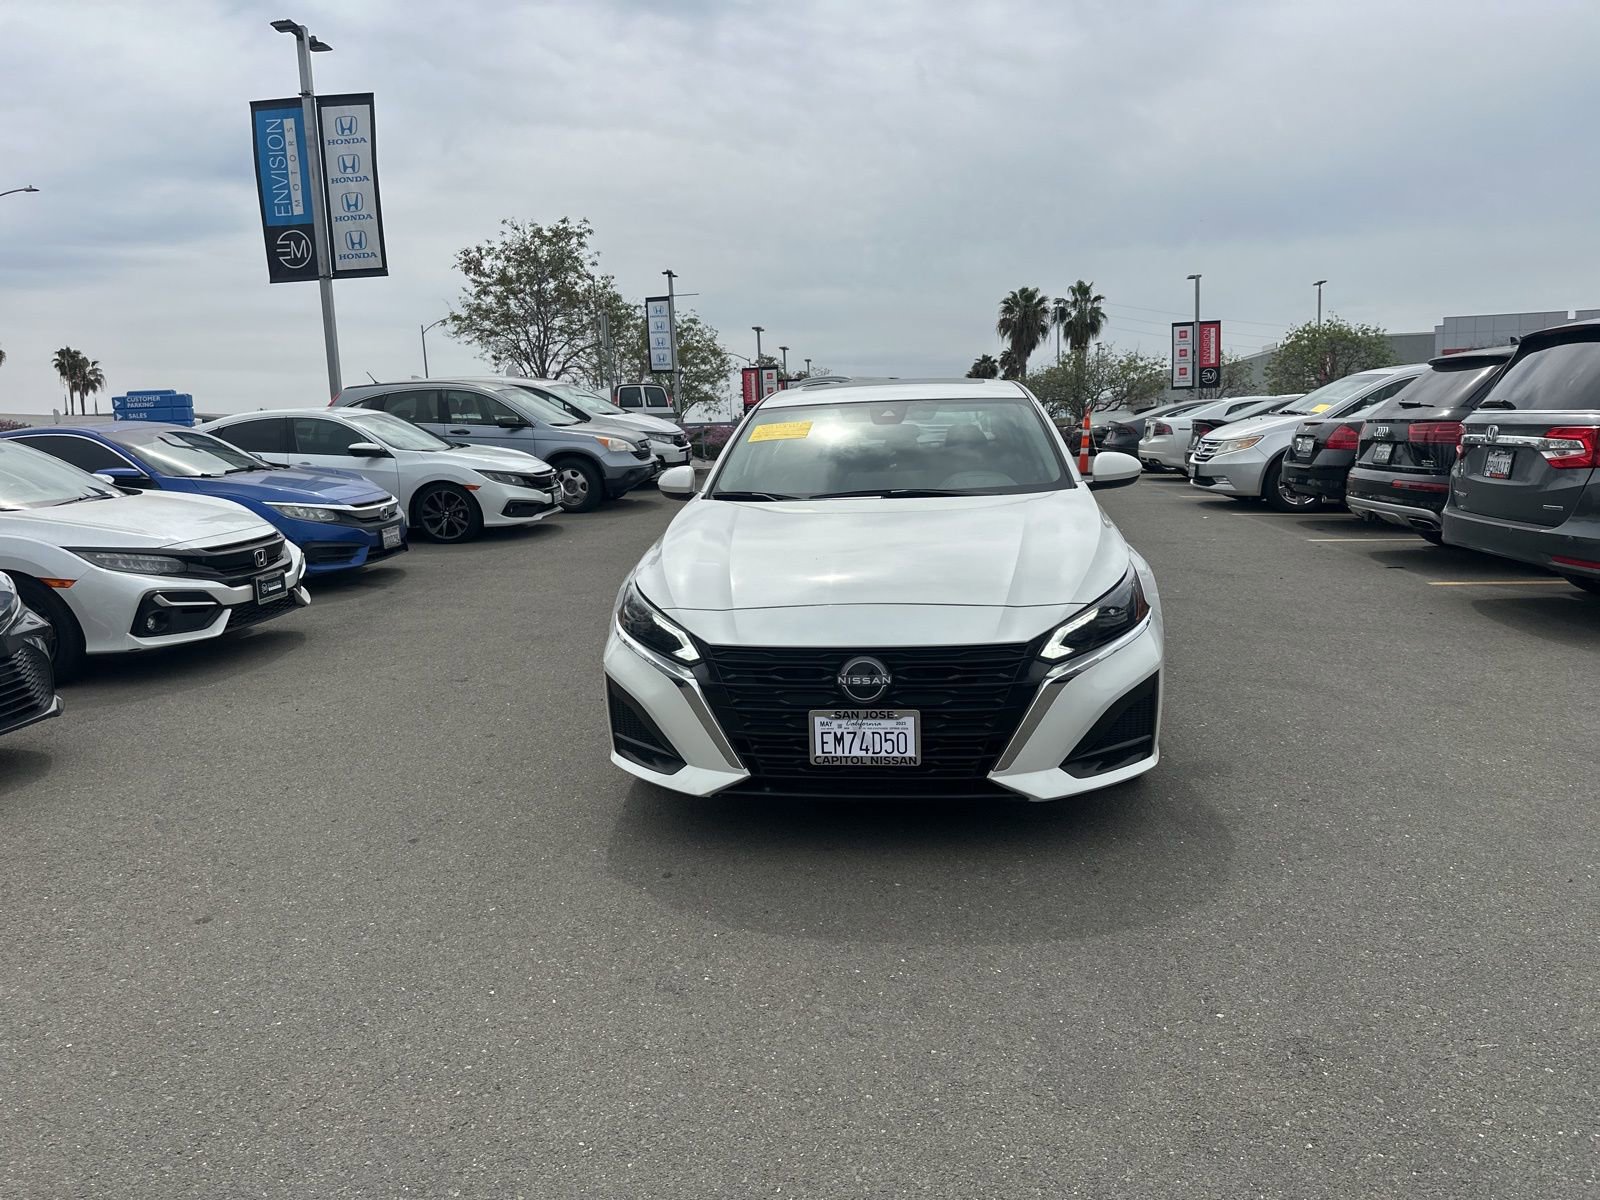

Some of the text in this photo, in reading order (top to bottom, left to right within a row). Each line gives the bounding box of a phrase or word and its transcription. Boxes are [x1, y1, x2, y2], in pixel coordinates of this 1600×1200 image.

[327, 137, 367, 146] HONDA
[266, 119, 291, 217] ENVISION
[287, 127, 302, 208] MOTORS
[331, 175, 370, 184] HONDA
[334, 213, 374, 222] HONDA
[338, 251, 378, 260] HONDA
[838, 676, 891, 685] NISSAN
[834, 710, 895, 719] SAN JOSE
[846, 719, 882, 730] California
[820, 731, 908, 755] EM74D50
[813, 756, 917, 765] CAPITOL NISSAN
